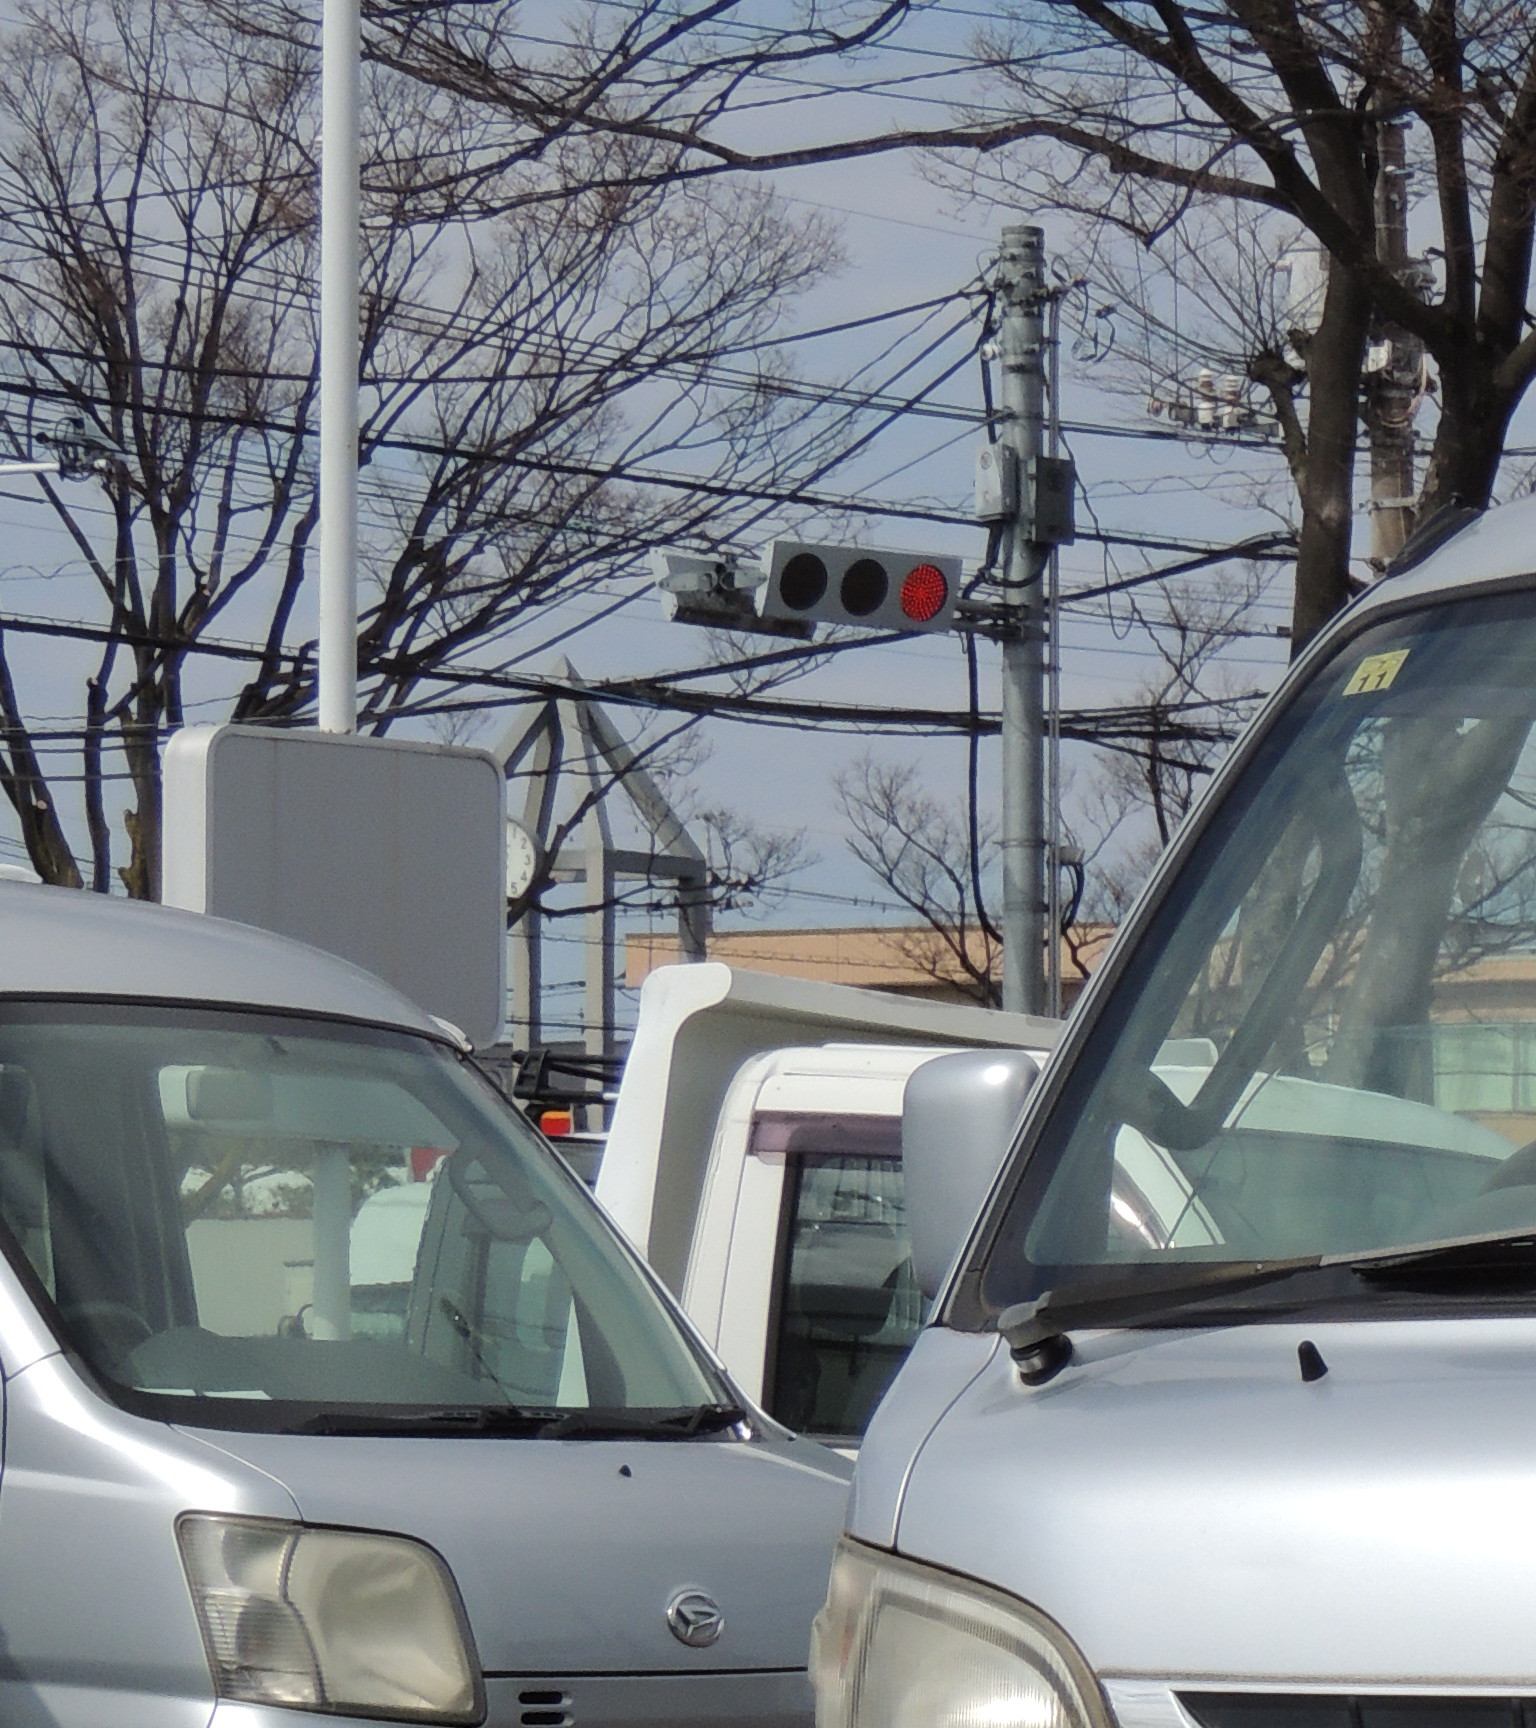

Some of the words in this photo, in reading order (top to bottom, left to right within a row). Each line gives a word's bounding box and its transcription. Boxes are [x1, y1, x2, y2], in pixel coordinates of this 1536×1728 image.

[1357, 672, 1388, 692] 11
[520, 838, 529, 850] 2
[524, 854, 532, 866] 3
[520, 870, 528, 881] 4
[510, 882, 519, 895] 5
